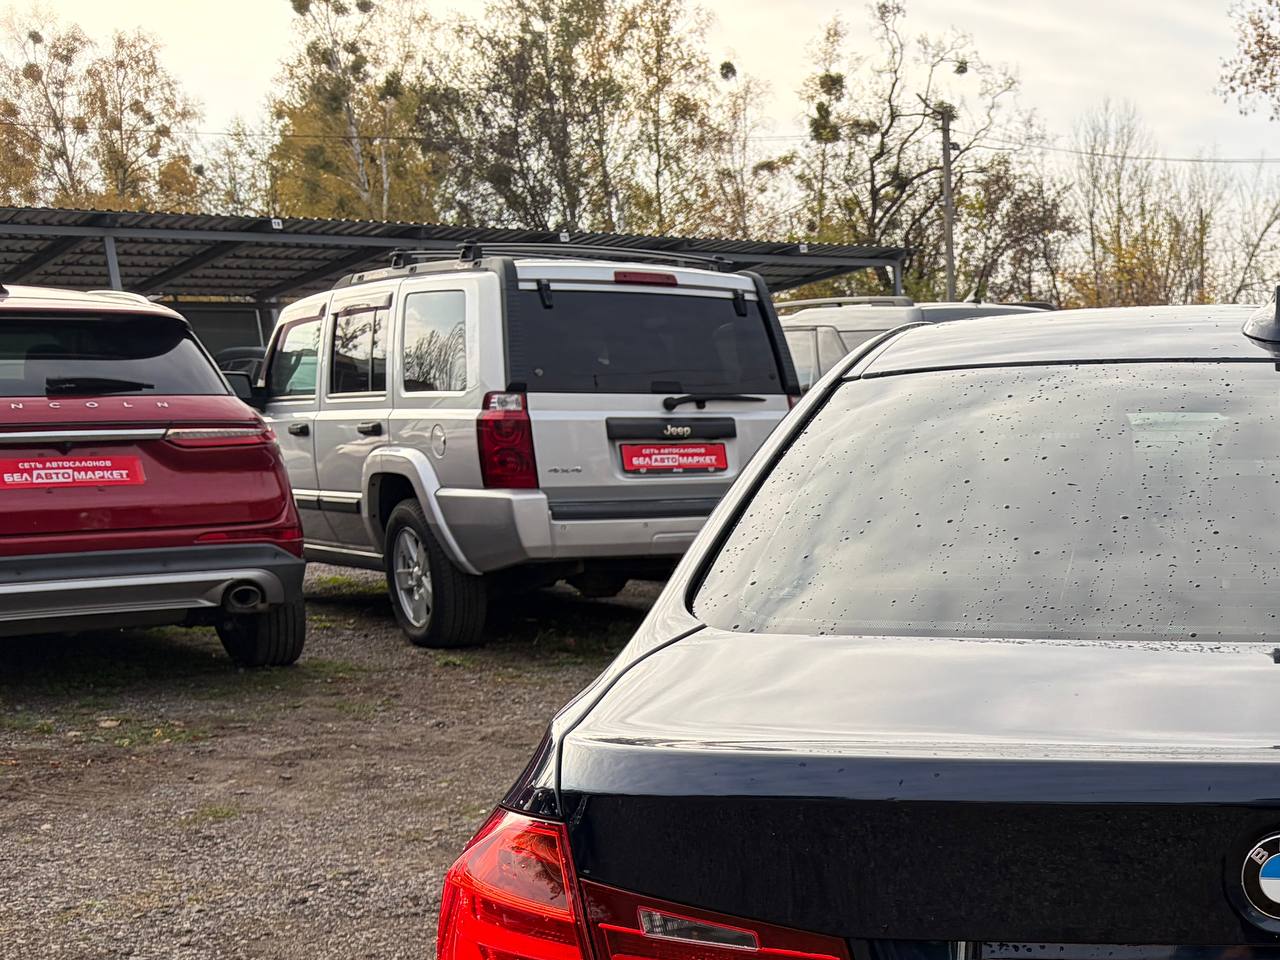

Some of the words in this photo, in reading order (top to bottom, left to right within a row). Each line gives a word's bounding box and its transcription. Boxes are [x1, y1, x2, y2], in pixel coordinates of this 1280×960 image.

[663, 424, 692, 437] Jeep
[18, 461, 43, 469] СЕТЬ
[45, 460, 112, 469] АВТОСАЛОНОВ
